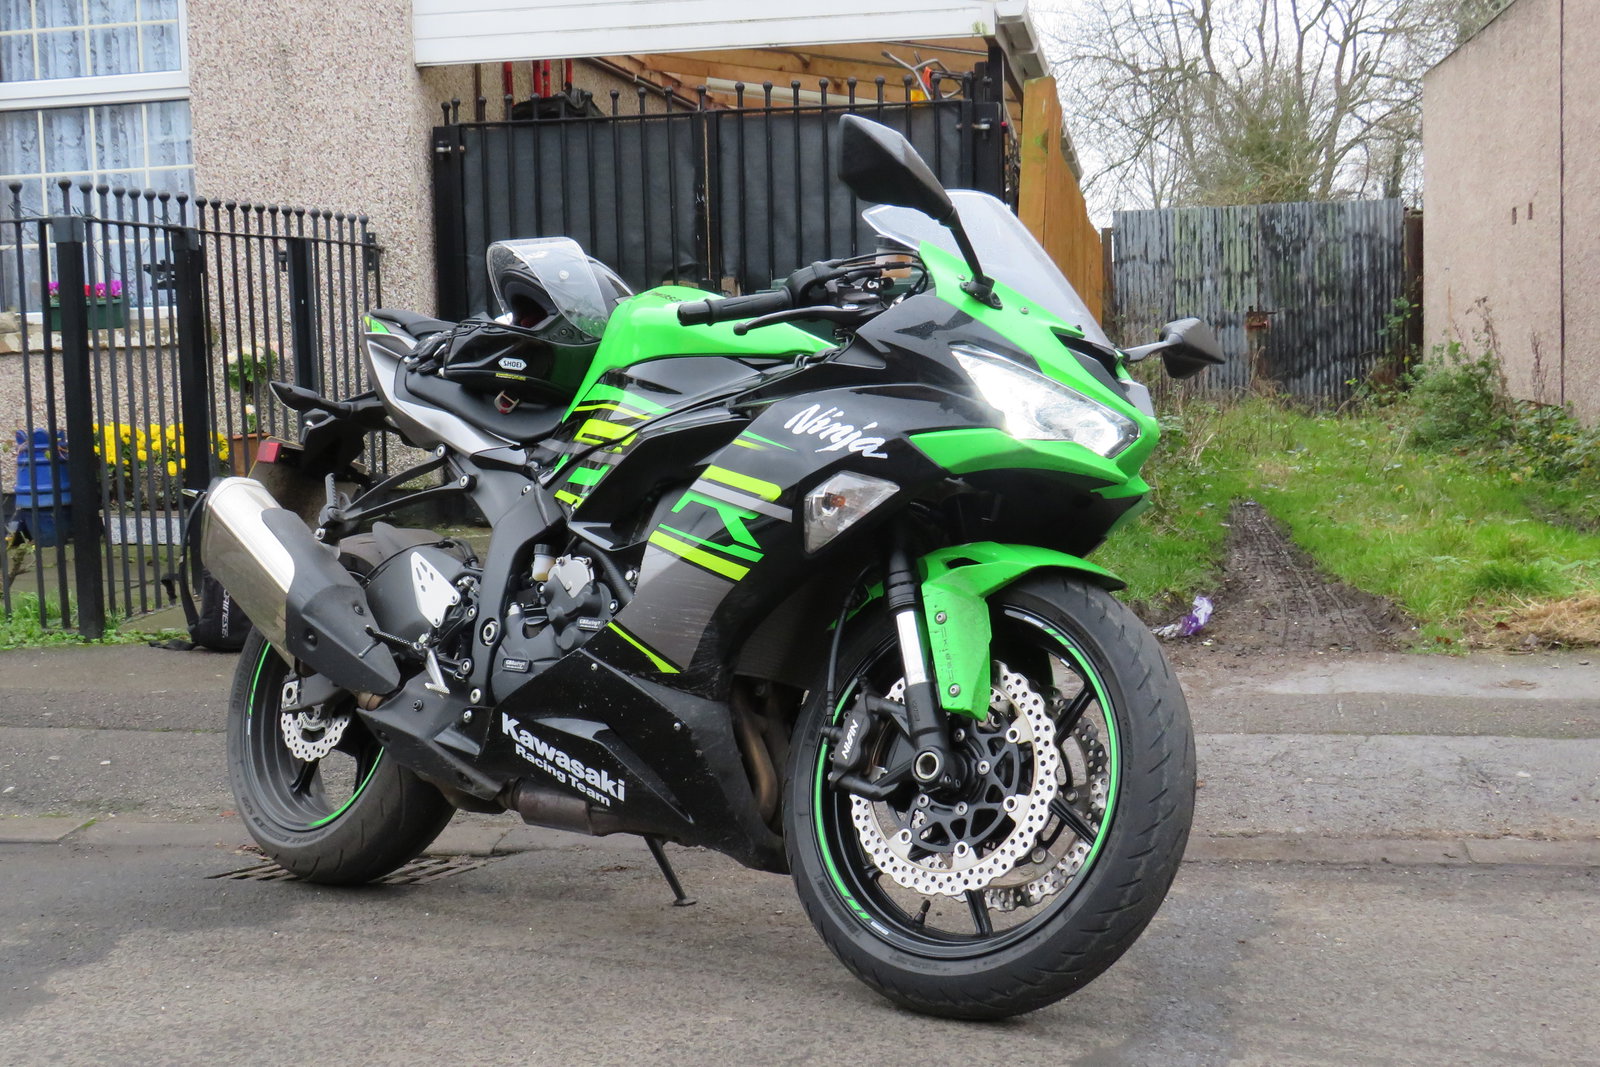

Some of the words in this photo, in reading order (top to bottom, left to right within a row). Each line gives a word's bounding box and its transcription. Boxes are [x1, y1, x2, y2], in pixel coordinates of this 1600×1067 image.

[503, 360, 522, 368] SHOEI
[783, 404, 888, 459] Ninja
[501, 711, 625, 802] Kawasaki
[515, 743, 566, 784] Racing
[568, 773, 611, 808] Team
